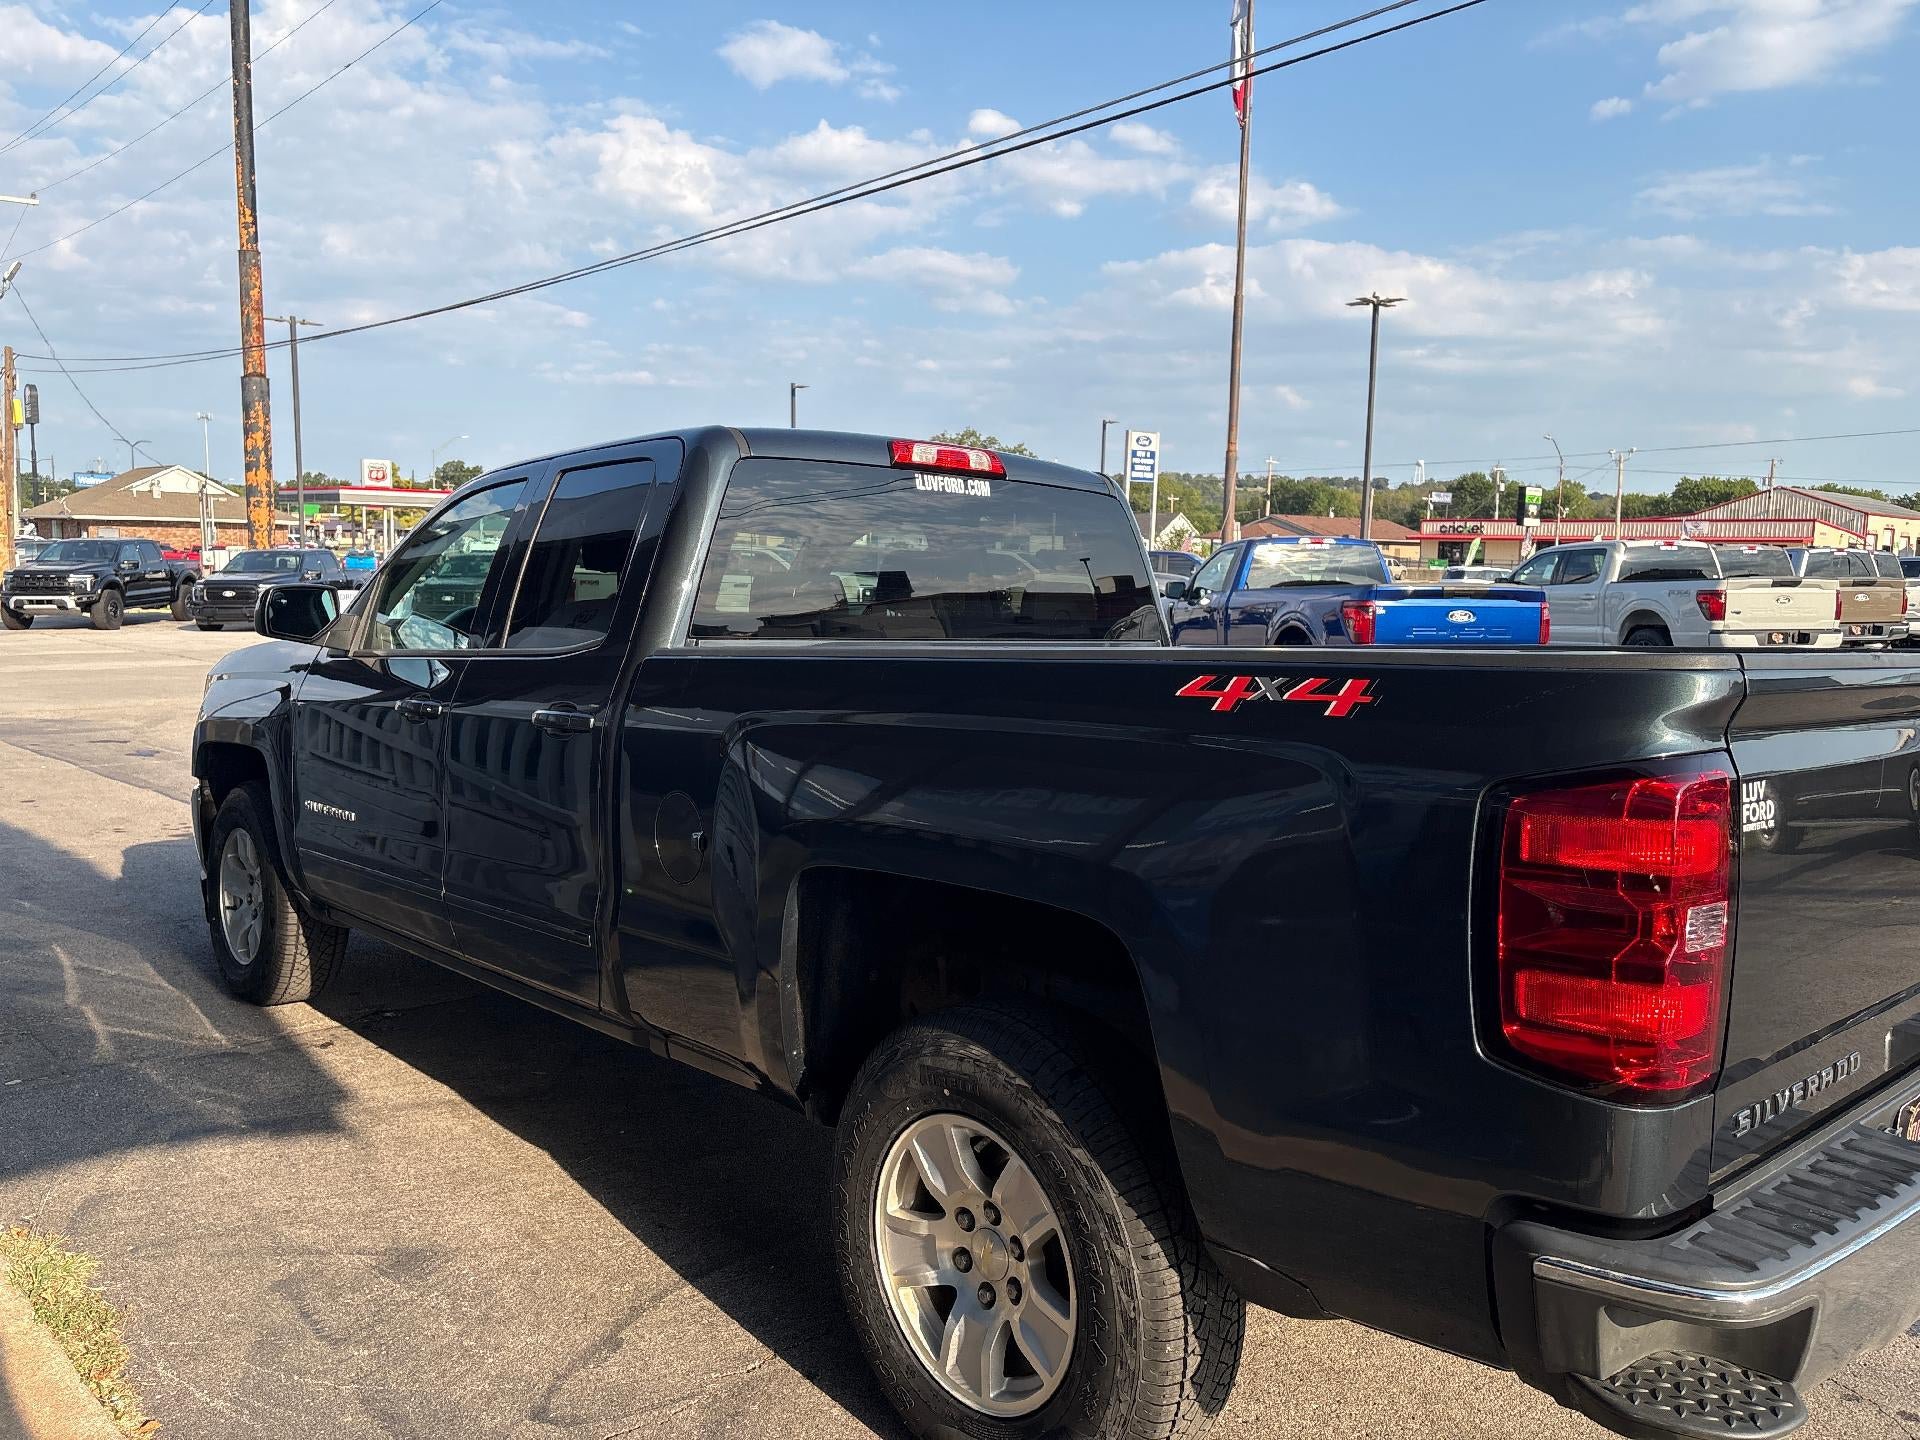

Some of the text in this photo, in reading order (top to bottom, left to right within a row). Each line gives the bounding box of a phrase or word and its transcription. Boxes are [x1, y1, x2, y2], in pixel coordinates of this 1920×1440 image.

[914, 473, 991, 497] iLUVFORD.COM
[1439, 521, 1486, 535] cricket
[1742, 779, 1767, 803] LUV
[304, 800, 357, 822] SILVERADO
[1742, 799, 1775, 824] FORD
[1730, 1050, 1860, 1138] SILVERADO
